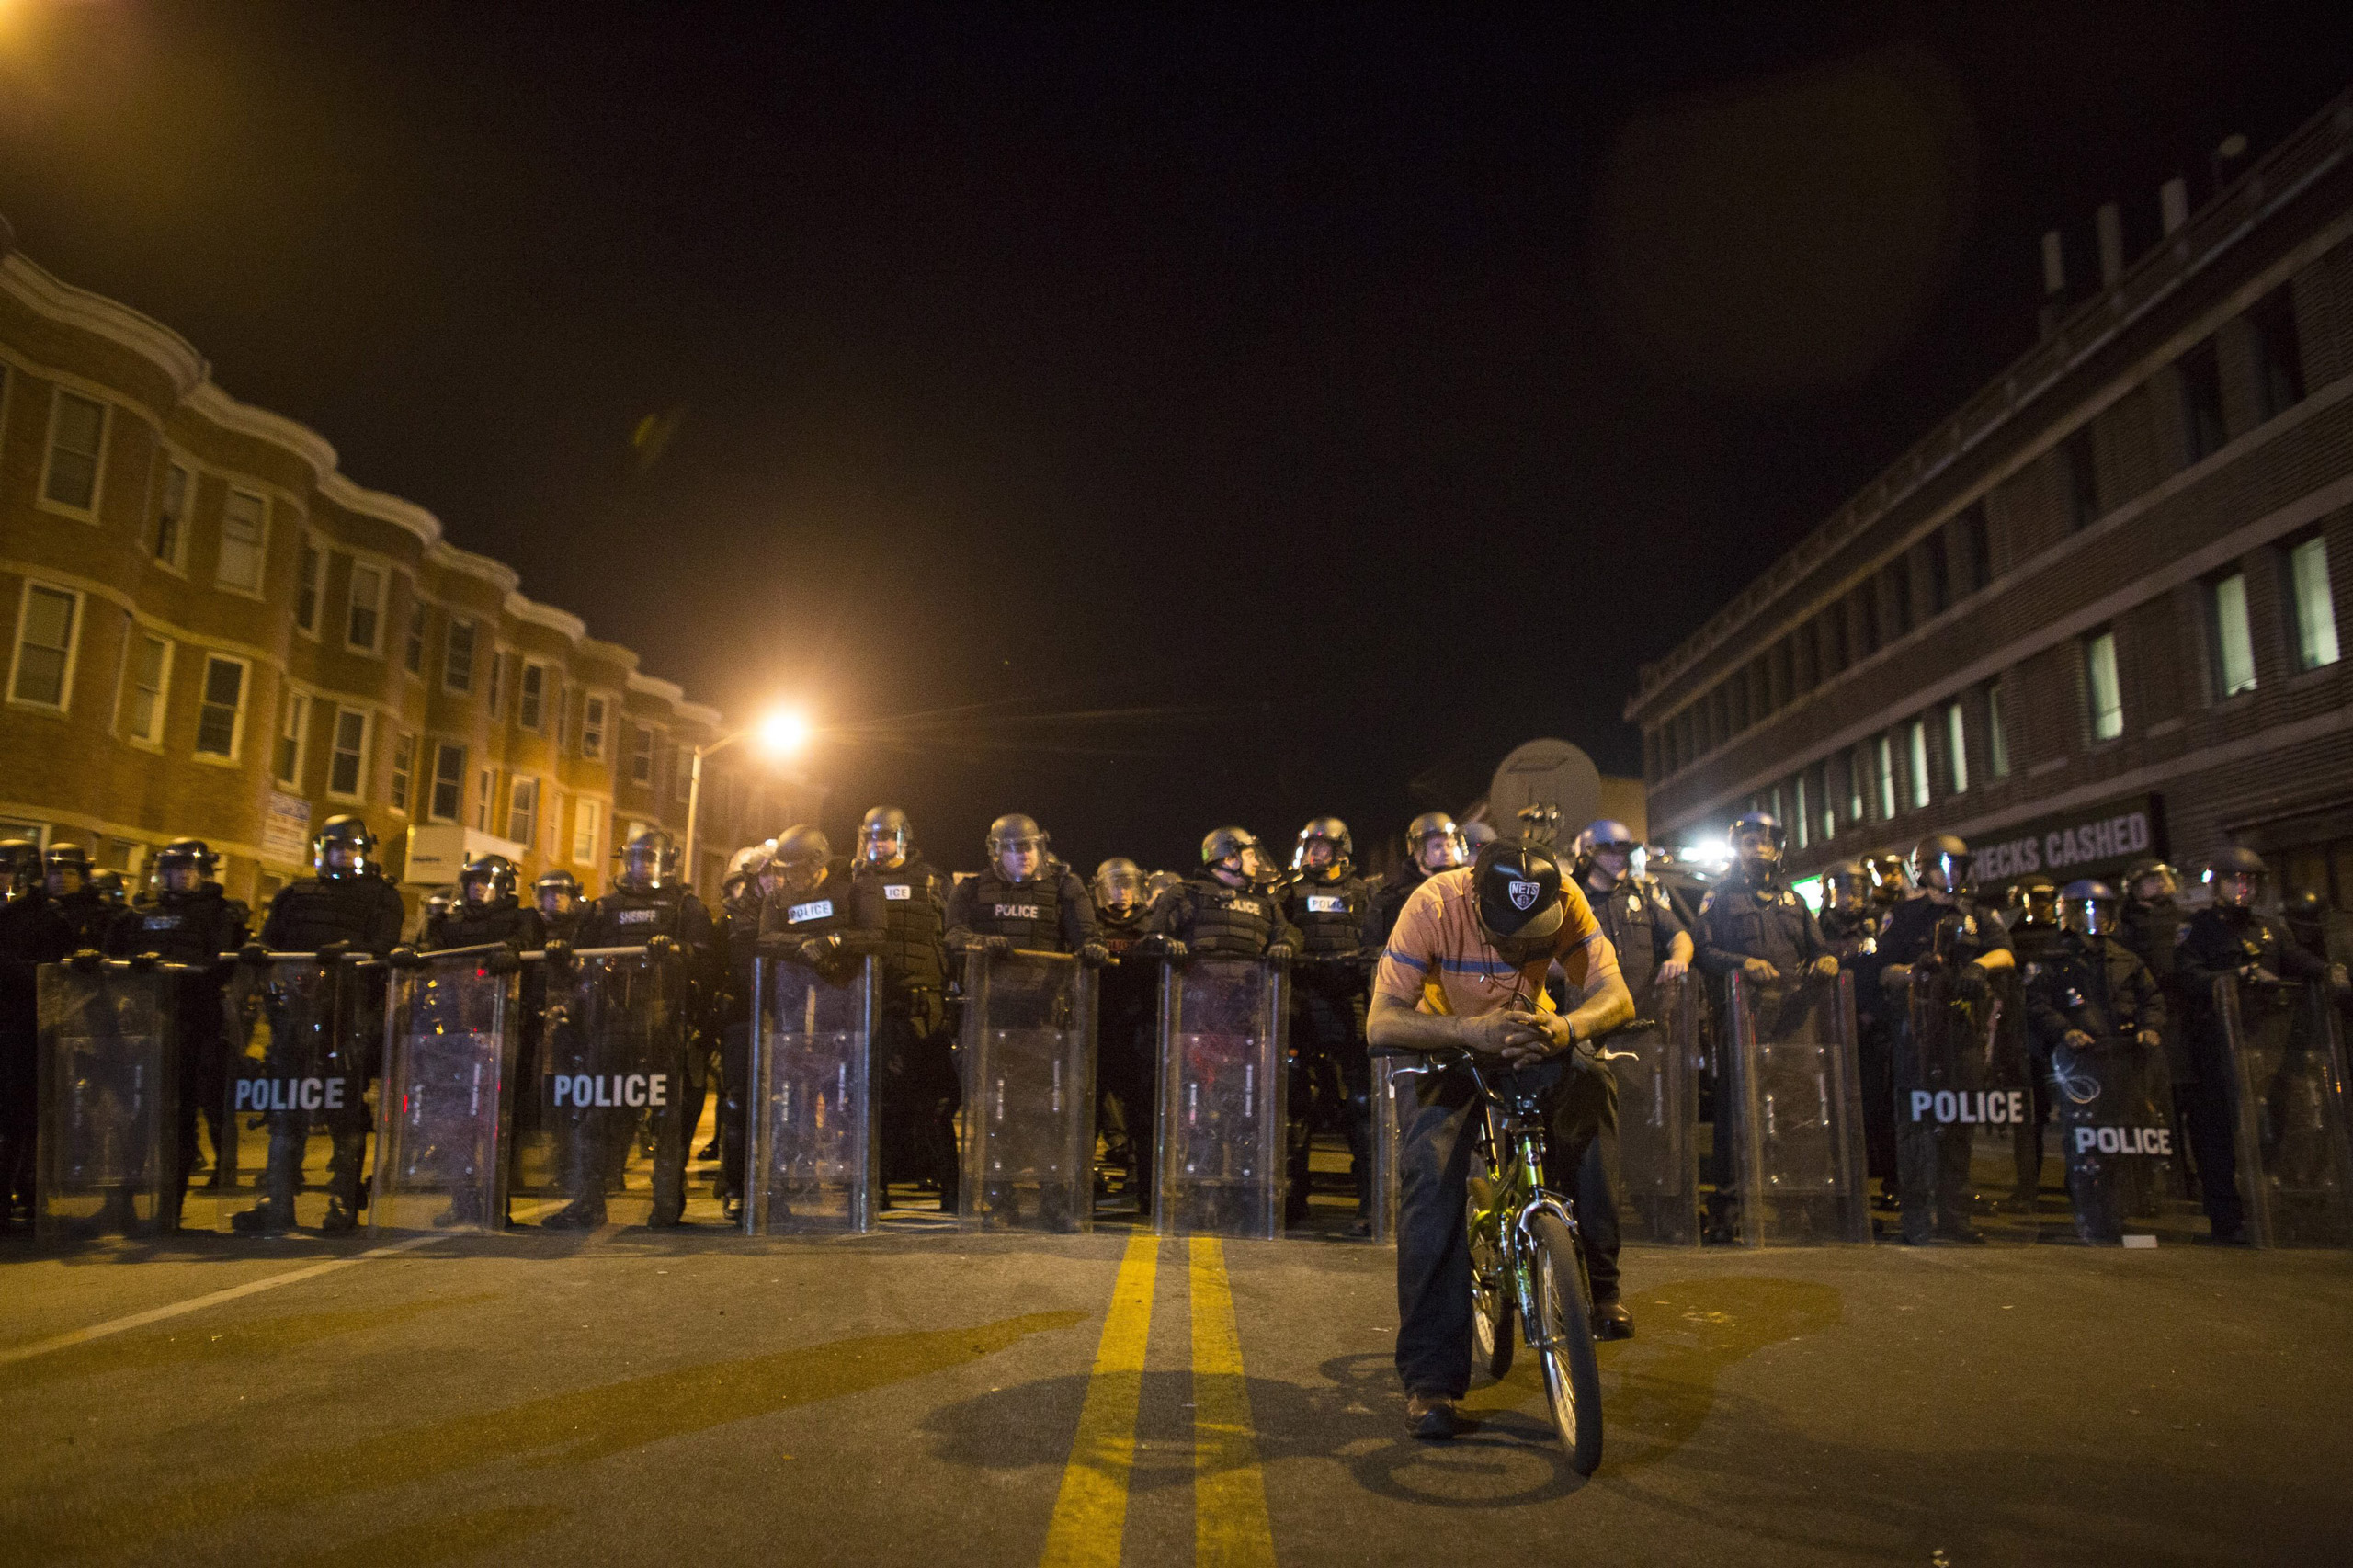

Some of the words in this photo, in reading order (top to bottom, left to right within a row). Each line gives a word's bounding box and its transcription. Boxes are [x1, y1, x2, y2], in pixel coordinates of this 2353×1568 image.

[1966, 836, 2040, 882] HECKS
[2045, 812, 2150, 869] CASHED
[888, 888, 908, 898] ICE
[1512, 883, 1538, 895] NETS
[790, 903, 830, 919] POLICE
[995, 903, 1039, 919] POLICE
[1312, 899, 1345, 910] POLIC
[618, 910, 656, 925] SHERIFF
[234, 1077, 346, 1111] POLICE
[553, 1074, 667, 1108] POLICE
[1911, 1090, 2024, 1124] POLICE
[2075, 1126, 2173, 1155] POLICE
